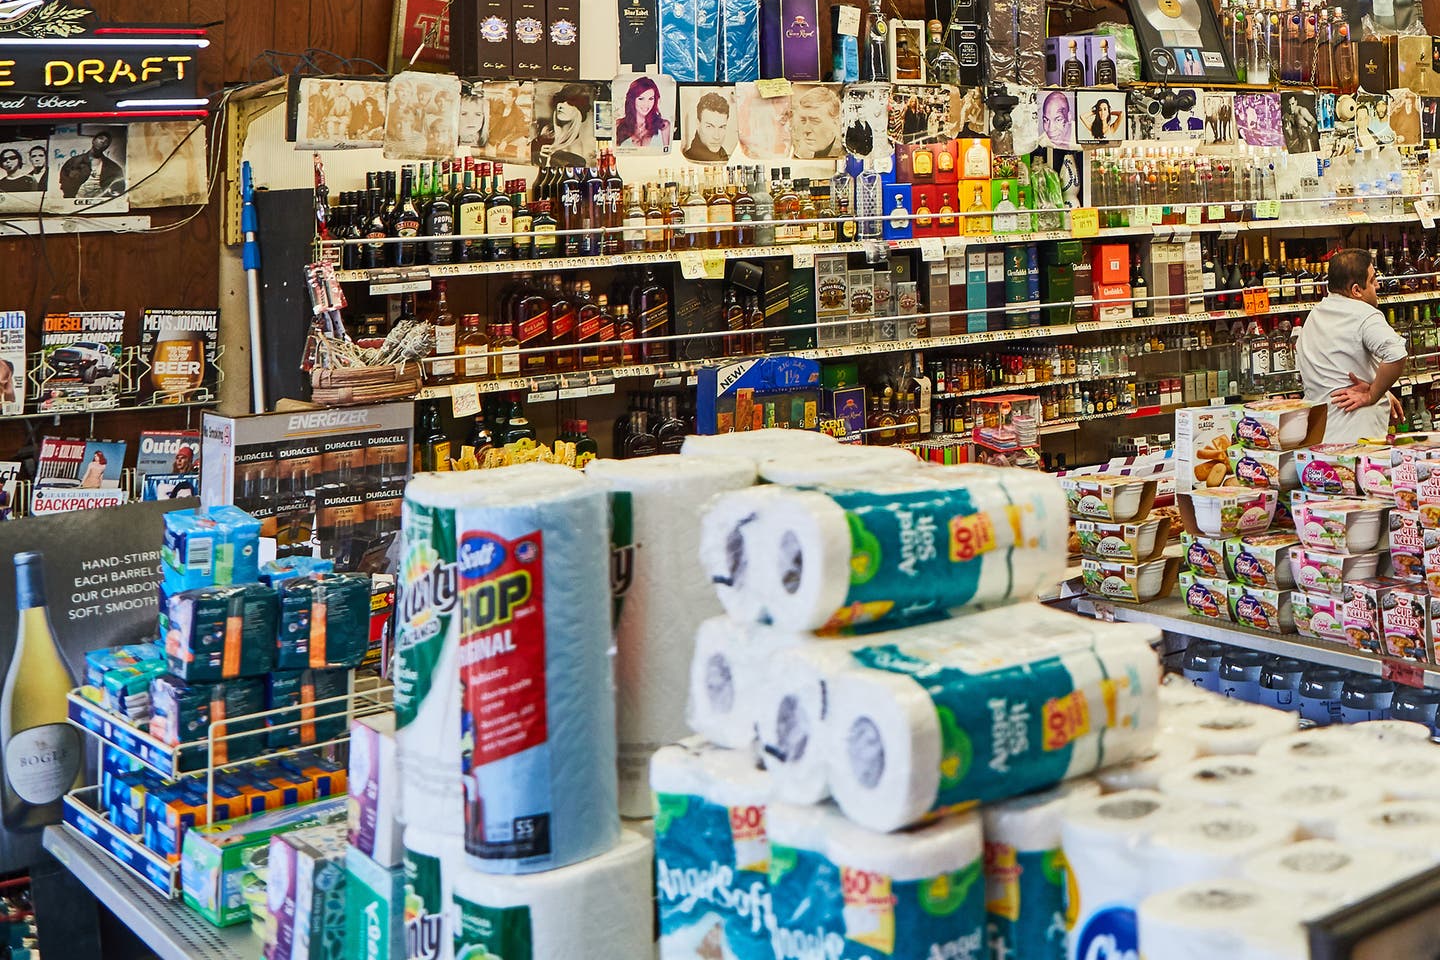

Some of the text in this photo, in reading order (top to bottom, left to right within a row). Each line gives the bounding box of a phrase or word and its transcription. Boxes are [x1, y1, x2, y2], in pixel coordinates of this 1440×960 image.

[45, 56, 191, 86] DRAFT
[37, 95, 86, 109] Beer
[45, 316, 123, 331] DIESEL POWER
[144, 315, 218, 331] MEN'S JOURNAL
[44, 331, 123, 345] WHITE KNIGHT
[154, 361, 200, 375] BEER
[720, 365, 746, 389] NEW!
[288, 409, 368, 431] ENERGIZER
[819, 419, 844, 428] SCENT
[235, 451, 274, 462] DURACELL
[280, 446, 319, 458] DURACELL
[898, 509, 916, 576] Angel
[916, 512, 938, 561] Soft
[74, 568, 151, 588] EACH BARREL
[71, 588, 97, 604] OUR
[105, 596, 158, 616] SMOOTH
[990, 697, 1008, 774] Angel
[1010, 699, 1030, 755] Soft
